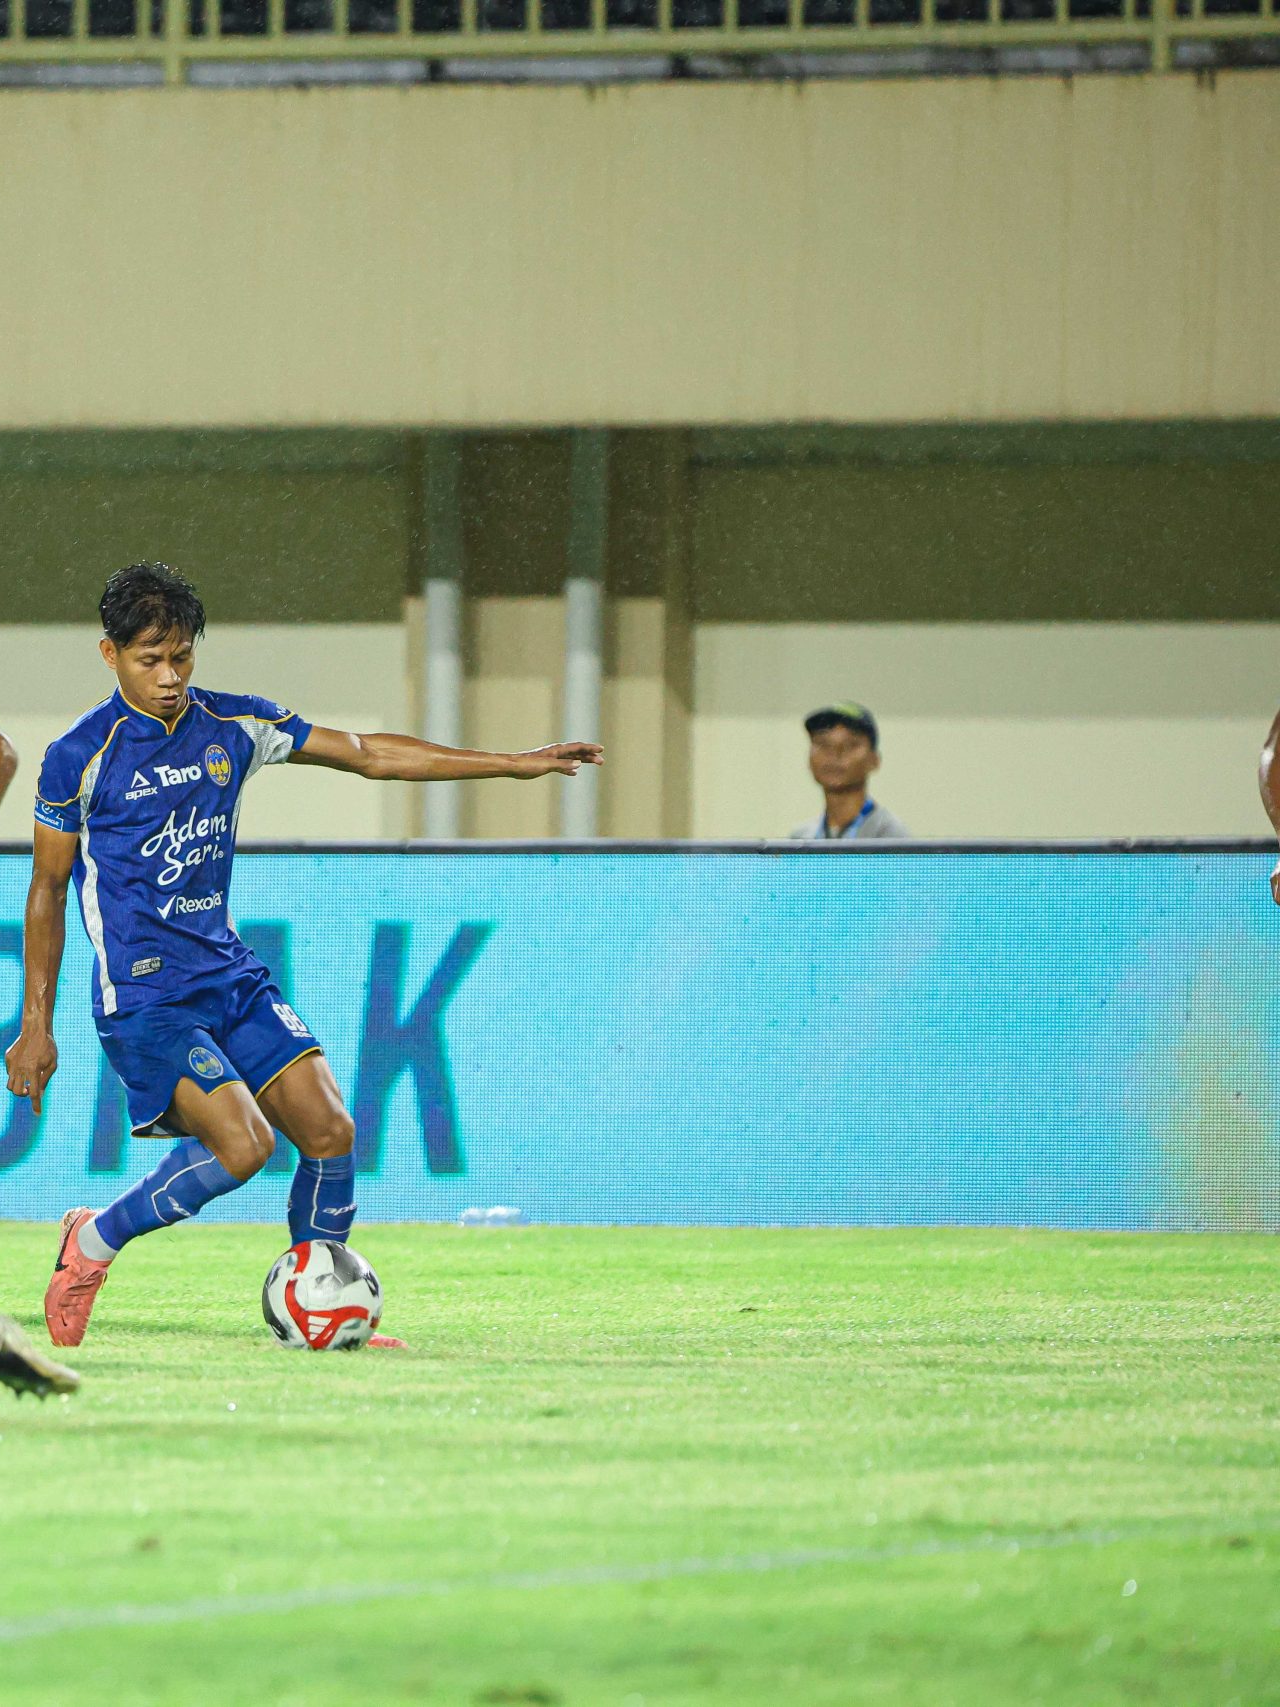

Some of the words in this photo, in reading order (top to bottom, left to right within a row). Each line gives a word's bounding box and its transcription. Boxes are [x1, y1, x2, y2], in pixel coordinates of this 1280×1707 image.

[125, 786, 158, 801] apex
[153, 763, 202, 787] Taro
[140, 806, 227, 857] Adem
[157, 836, 220, 886] Sari
